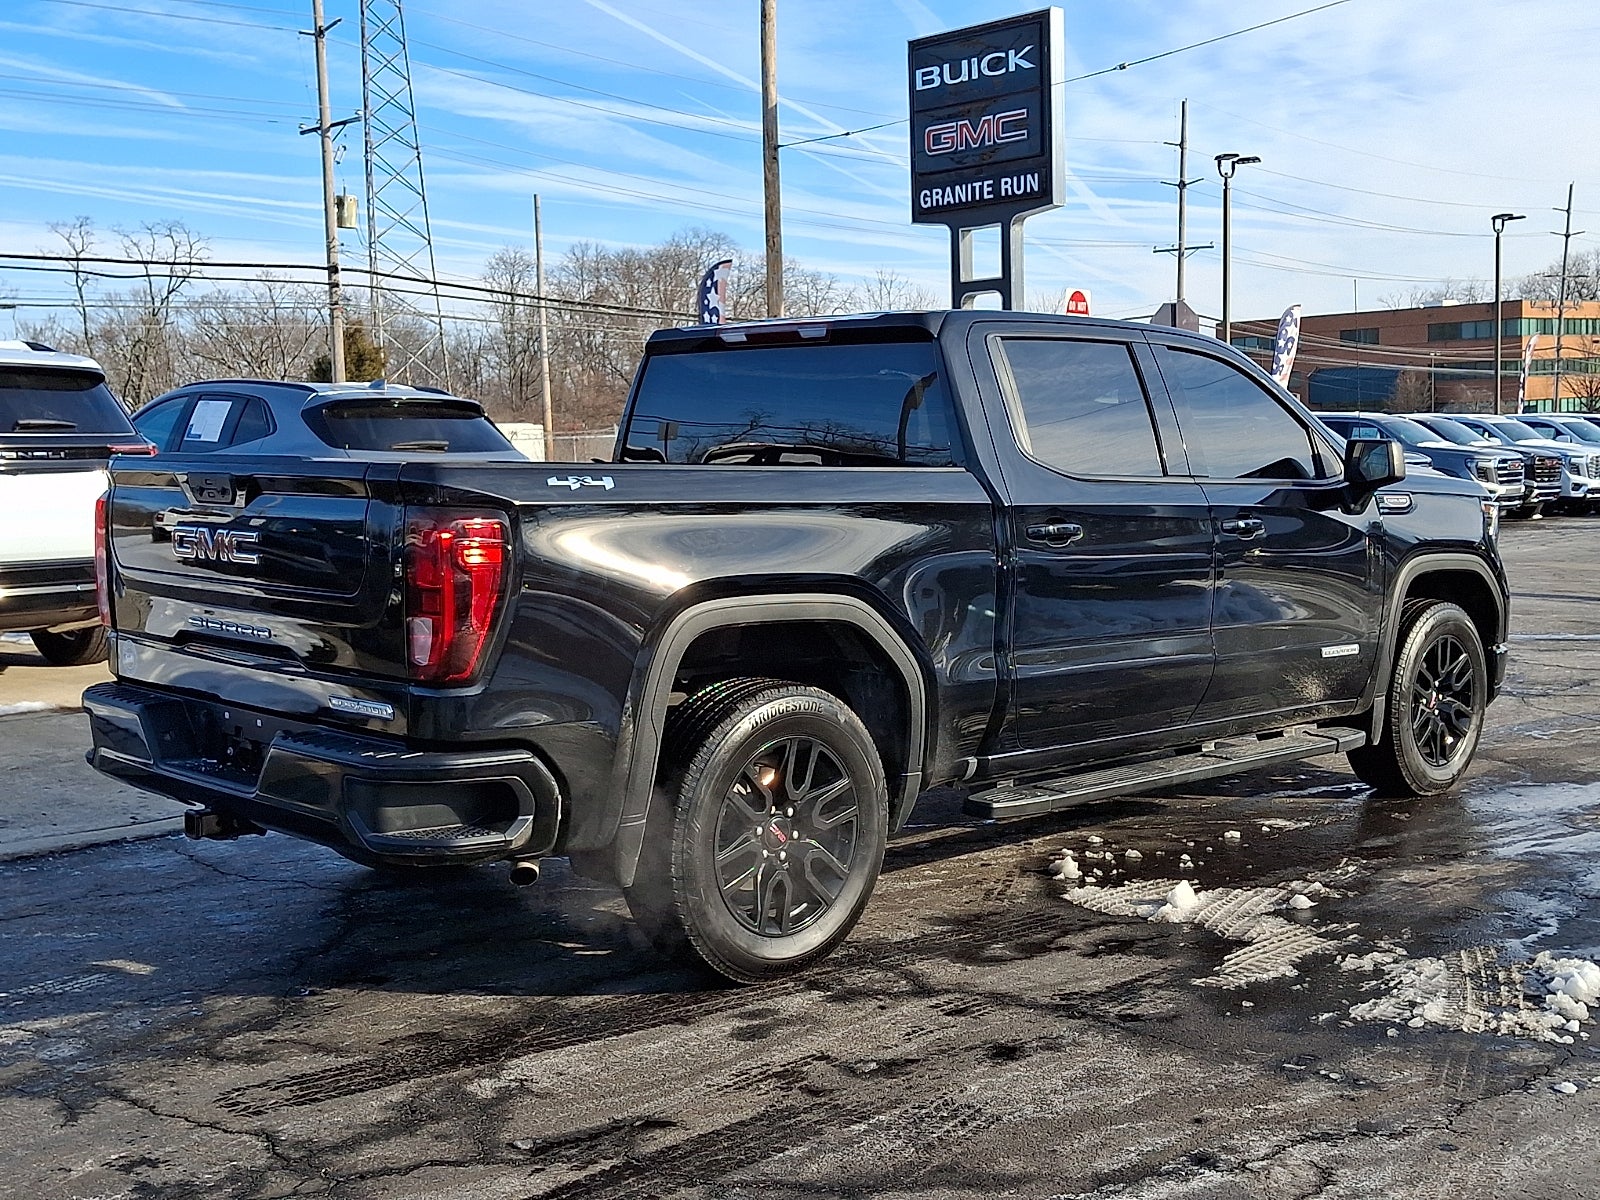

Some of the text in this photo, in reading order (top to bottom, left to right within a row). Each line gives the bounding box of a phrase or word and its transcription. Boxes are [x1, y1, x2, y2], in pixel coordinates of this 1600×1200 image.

[915, 45, 1037, 91] BUICK
[924, 108, 1028, 156] GMC
[920, 173, 1039, 208] GRANITE RUN
[0, 451, 65, 459] ENALI
[171, 526, 259, 565] GMC
[749, 701, 825, 730] BRIDGESTONE
